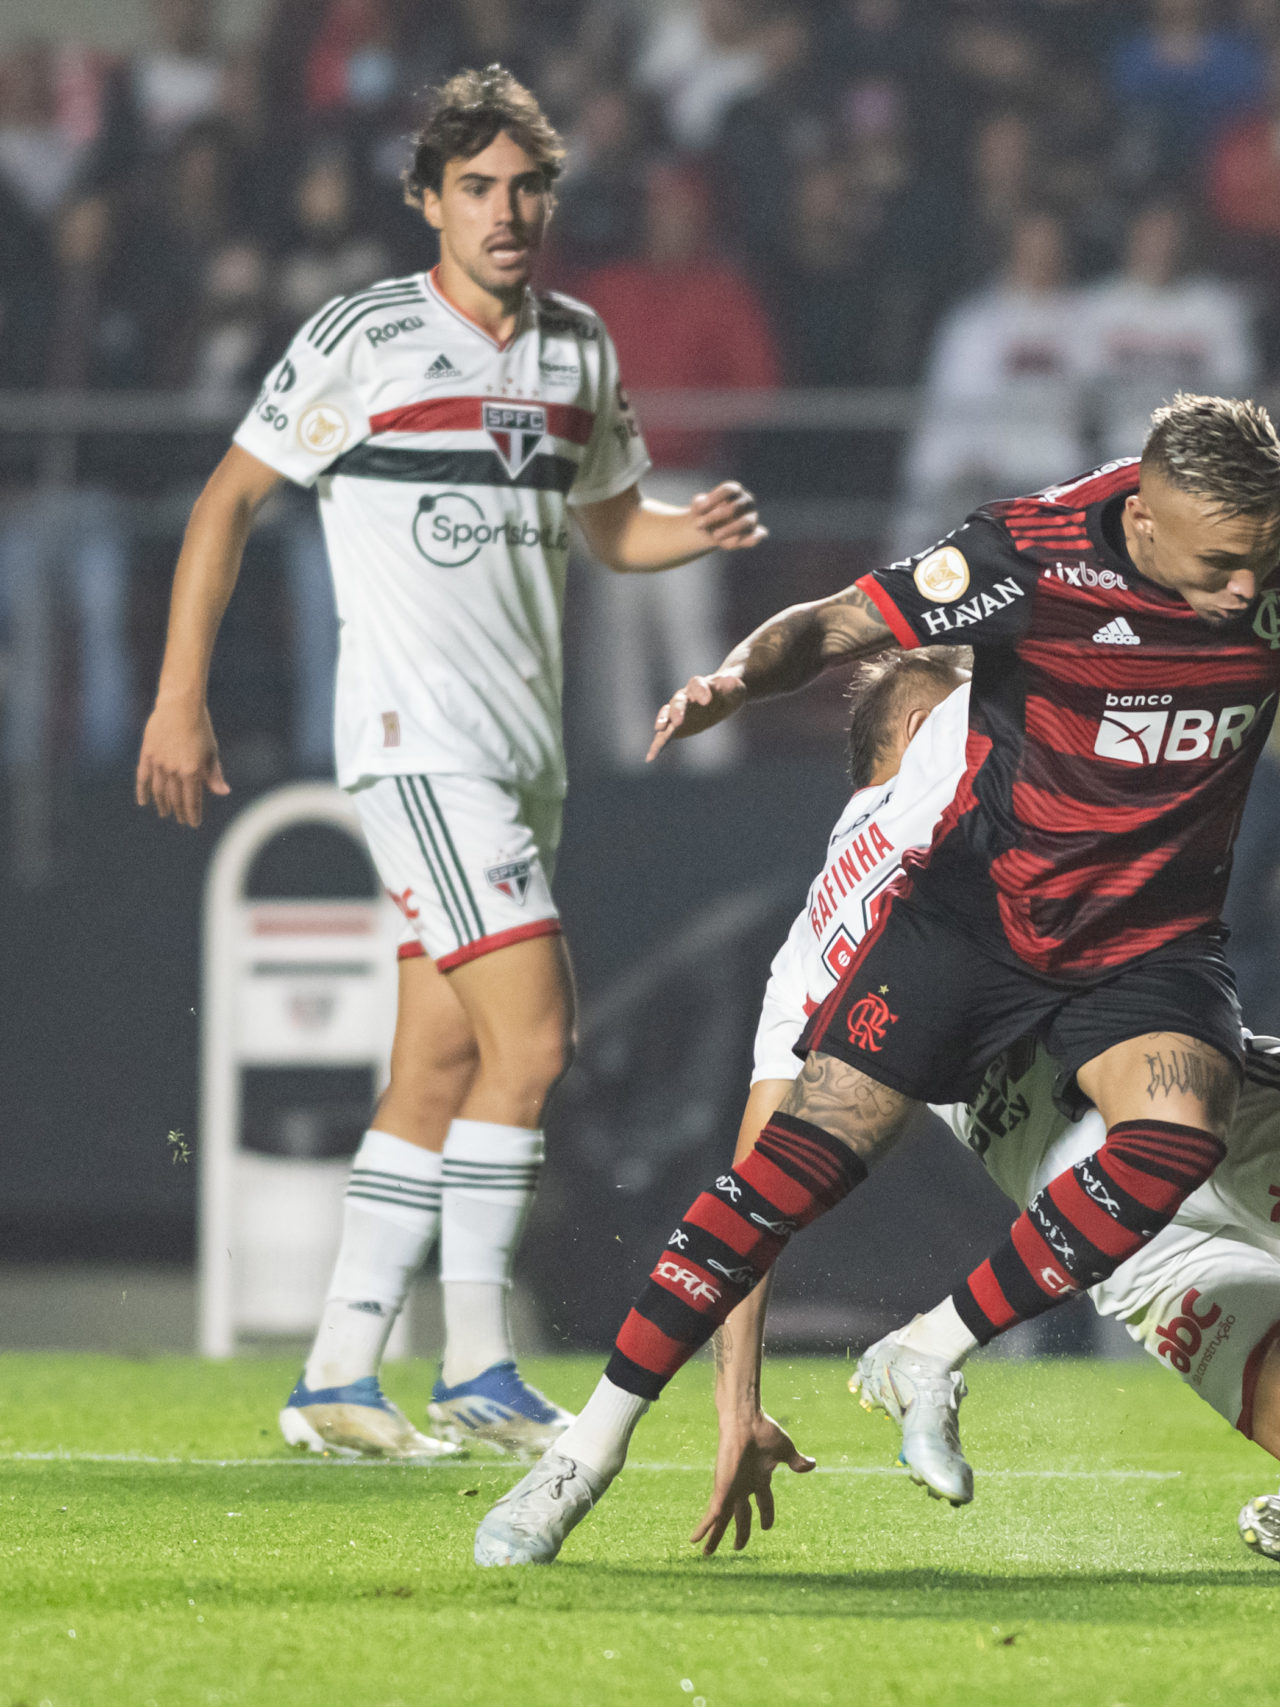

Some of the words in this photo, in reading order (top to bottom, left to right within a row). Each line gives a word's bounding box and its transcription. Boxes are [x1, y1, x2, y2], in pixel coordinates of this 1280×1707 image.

[489, 410, 543, 428] SPFC
[1043, 560, 1129, 590] ixbet
[921, 576, 1025, 636] HAVAN
[1092, 633, 1141, 645] adidas
[1105, 692, 1173, 707] banco
[1164, 704, 1257, 761] BR
[810, 821, 895, 942] RAFINHA
[1156, 1287, 1222, 1374] abc
[1197, 1313, 1237, 1377] construção
